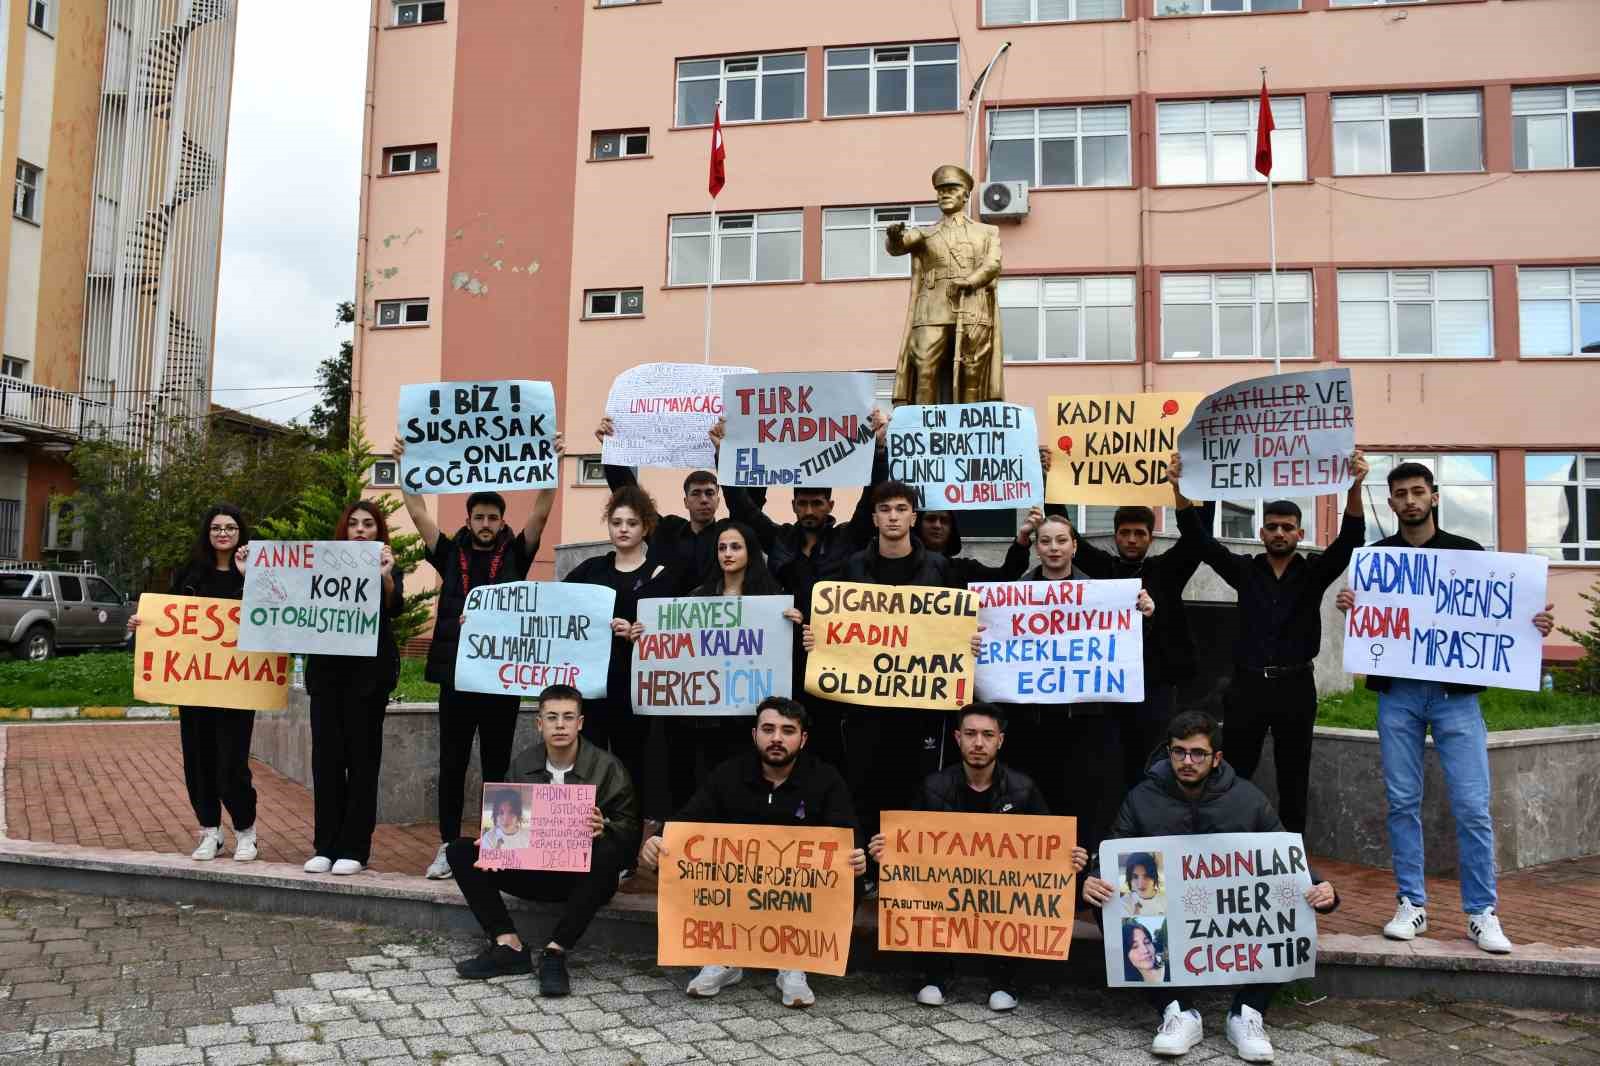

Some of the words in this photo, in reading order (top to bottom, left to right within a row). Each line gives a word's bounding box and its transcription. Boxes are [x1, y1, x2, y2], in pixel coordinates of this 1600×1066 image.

[454, 384, 499, 415] BİZ
[735, 385, 813, 416] TÜRK
[1314, 380, 1348, 404] VE
[923, 406, 947, 430] İÇİN
[959, 406, 1022, 429] ADALET
[1056, 400, 1135, 426] KADIN
[405, 414, 545, 443] SUSARSAK
[758, 414, 858, 443] KADINI
[929, 431, 1005, 456] BIRAKTIM
[1085, 426, 1175, 457] KADININ
[464, 439, 553, 464] ONLAR
[735, 447, 766, 471] EL
[1253, 433, 1310, 458] İDAM
[405, 460, 555, 491] ÇOĞALACAK
[254, 544, 315, 569] ANNE
[310, 573, 370, 603] KORK
[1353, 552, 1438, 596] KADININ
[656, 597, 743, 630] HİKAYESİ
[814, 585, 905, 615] SİGARA
[250, 606, 378, 635] OTOBÜSTEYİM
[520, 615, 591, 641] UMUTLAR
[826, 621, 909, 648] KADIN
[1011, 608, 1132, 637] KORUYUN
[466, 633, 552, 665] SOLMAMALI
[637, 631, 696, 661] YARIM
[700, 628, 764, 656] KALAN
[976, 634, 1116, 665] ERKEKLERİ
[873, 652, 964, 674] OLMAK
[636, 669, 721, 707] HERKES
[1018, 665, 1126, 695] EĞİTİN
[896, 828, 1061, 860] KIYAMAYIP
[879, 864, 1074, 890] SARILAMADIKLARIMIZIN
[1182, 845, 1306, 881] KADINLAR
[747, 888, 812, 913] SIRAMI
[946, 887, 1062, 918] SARILMAK
[1216, 882, 1272, 914] HER
[884, 909, 1068, 957] İSTEMİYORUZ
[1185, 908, 1297, 939] ZAMAN
[683, 918, 840, 961] BEKLİYORDUM
